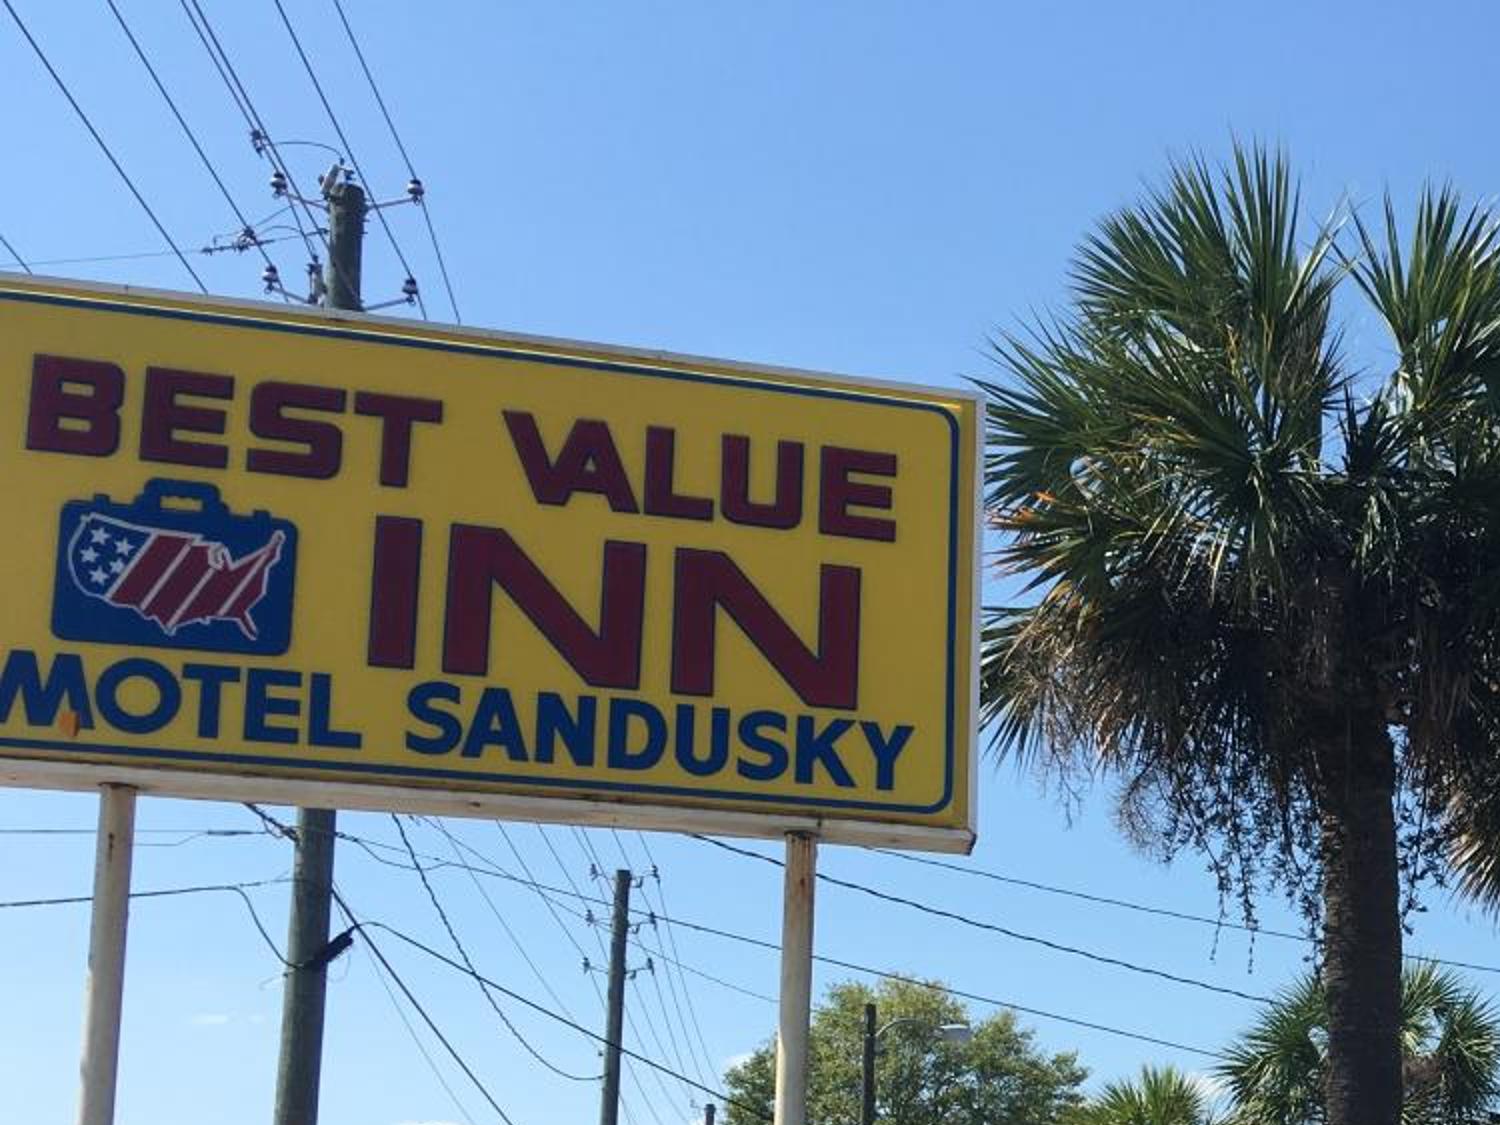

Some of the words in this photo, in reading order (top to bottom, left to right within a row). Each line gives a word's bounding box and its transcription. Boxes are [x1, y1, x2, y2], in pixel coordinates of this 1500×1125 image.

[26, 353, 443, 488] BEST
[502, 409, 897, 543] VALUE
[367, 515, 863, 711] INN
[0, 649, 362, 749] MOTEL
[405, 681, 915, 791] SANDUSKY
